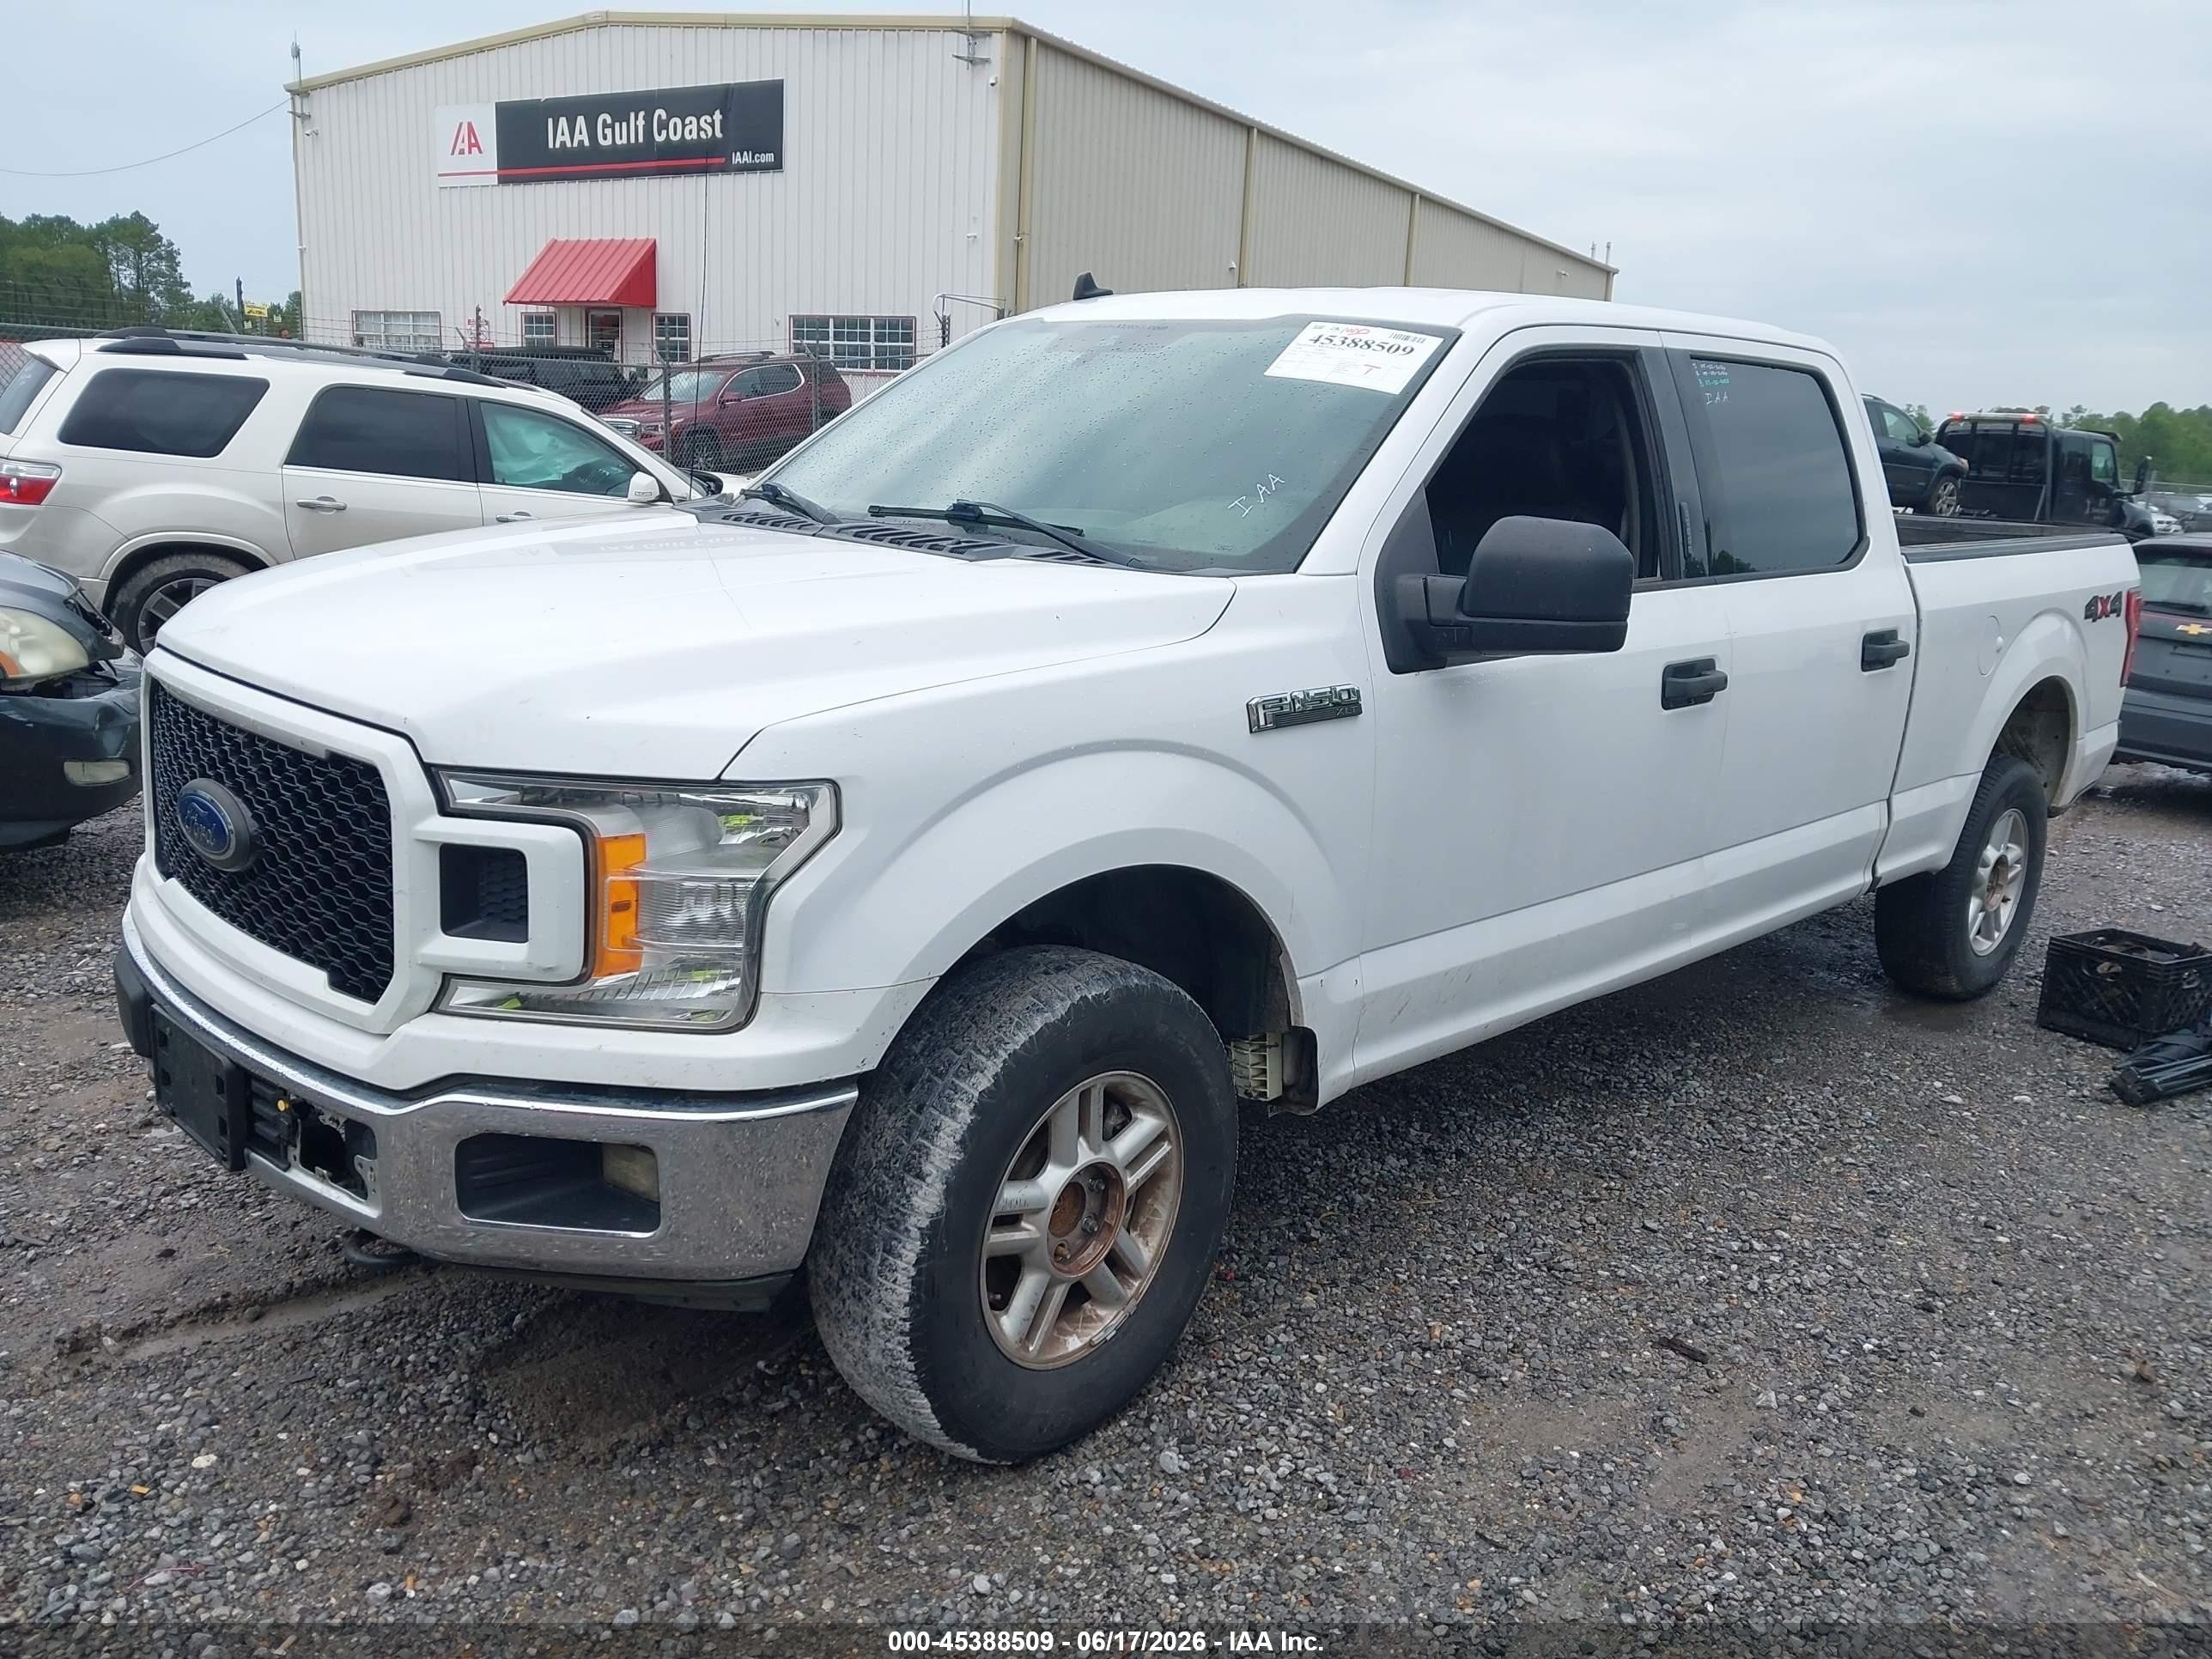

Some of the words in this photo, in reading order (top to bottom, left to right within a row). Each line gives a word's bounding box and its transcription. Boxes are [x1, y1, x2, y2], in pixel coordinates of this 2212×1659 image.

[547, 115, 590, 149] IAA
[597, 111, 645, 146] Gulf
[653, 108, 723, 142] Coast
[1309, 333, 1415, 356] 45388509
